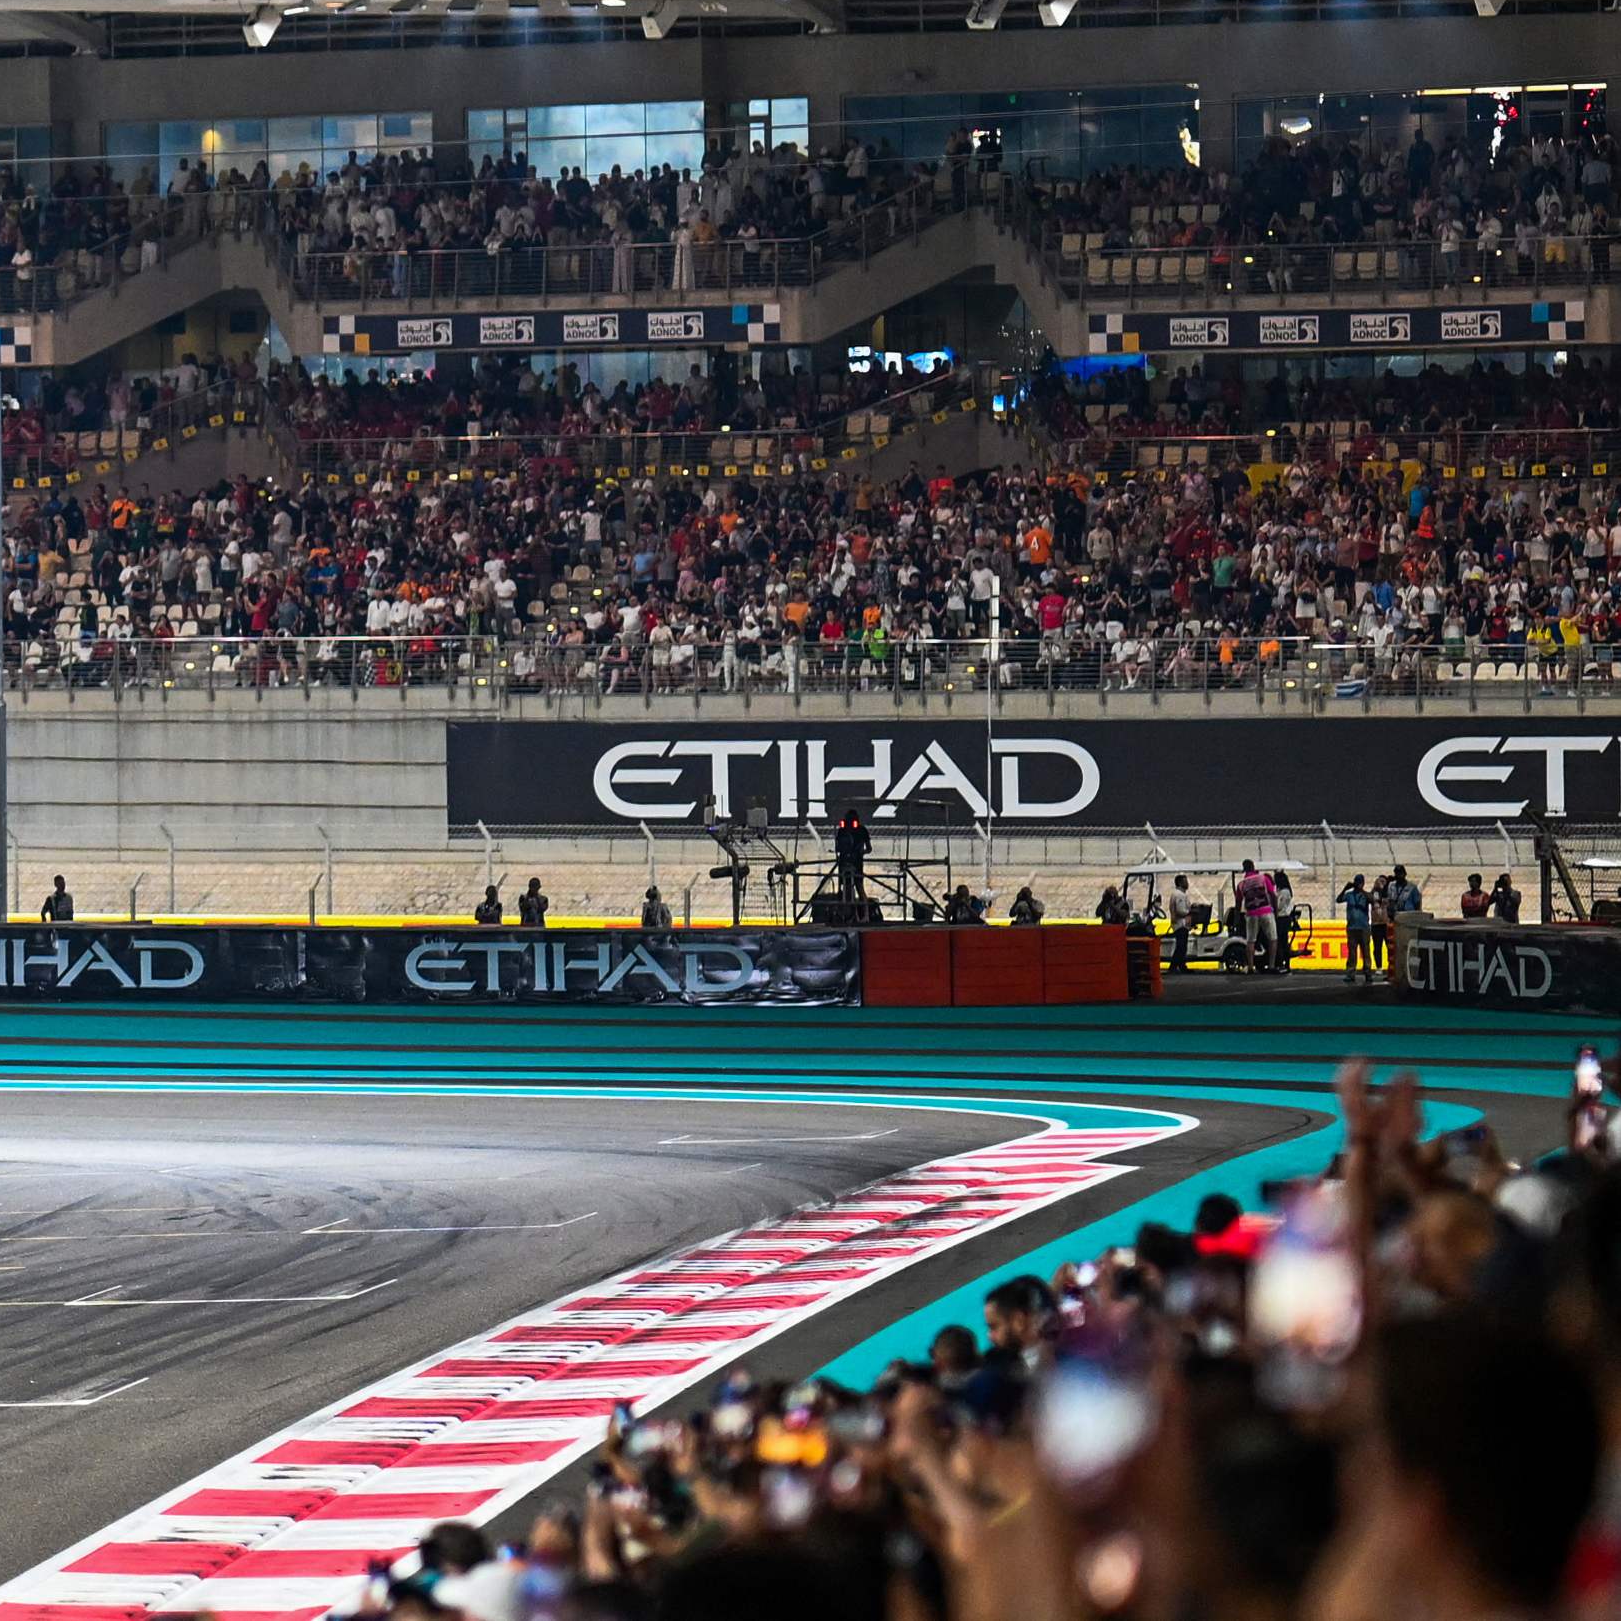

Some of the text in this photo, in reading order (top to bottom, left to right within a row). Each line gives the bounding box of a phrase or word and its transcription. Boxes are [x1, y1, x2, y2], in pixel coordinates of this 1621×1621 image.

[482, 332, 514, 341] ADNOC
[565, 330, 598, 340] ADNOC
[650, 328, 682, 337] ADNOC
[1262, 331, 1297, 341] ADNOC
[1352, 329, 1387, 339] ADNOC
[1443, 327, 1478, 337] ADNOC
[400, 335, 432, 344] ADNOC
[1172, 333, 1206, 343] ADNOC
[593, 738, 1100, 819] ETIHAD
[1417, 736, 1621, 817] ET
[405, 941, 753, 993] ETIHAD
[1407, 939, 1552, 998] ETIHAD
